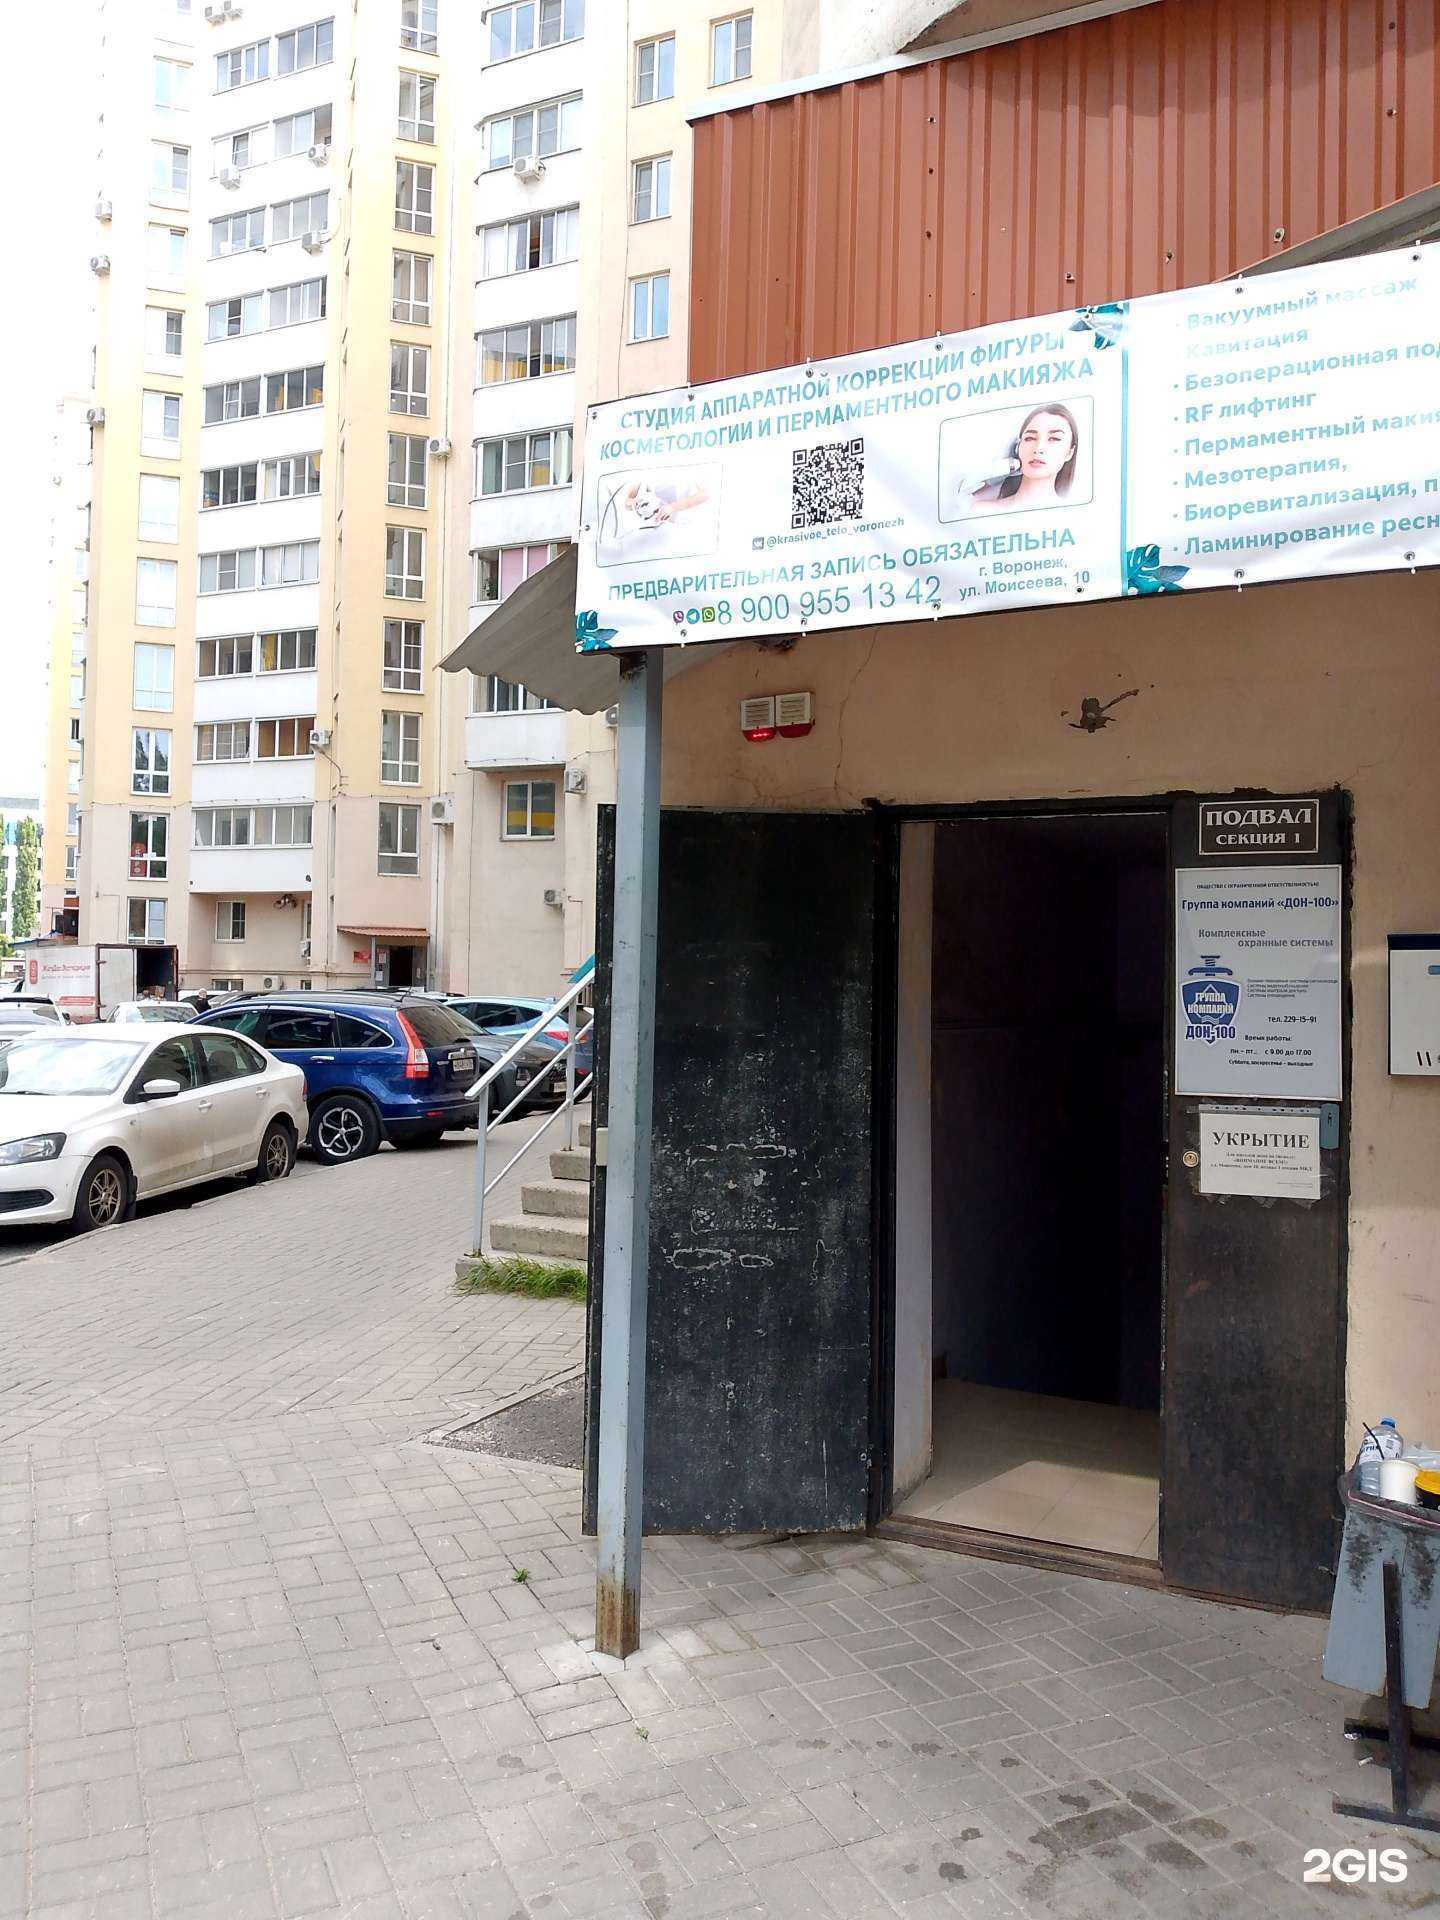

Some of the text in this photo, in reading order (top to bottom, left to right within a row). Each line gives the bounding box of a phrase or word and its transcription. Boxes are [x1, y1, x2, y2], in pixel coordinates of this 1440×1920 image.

[1187, 278, 1417, 330] Вакуумный массаж
[1186, 328, 1310, 359] Кавитация
[620, 331, 1065, 431] СТУДИЯ АППАРАТНОЙ КОРРЕКЦИИ ФИГУРЫ
[1185, 340, 1440, 392] Безоперационная по
[600, 357, 1094, 461] КОСМЕТОЛОГИИ И ПЕРМАМЕНТНОГО МАКИЯЖА
[1185, 393, 1317, 424] RF лифтинг
[1185, 415, 1366, 456] Пермаментный
[1184, 457, 1347, 488] Мезотерапия,
[1184, 481, 1417, 521] Биоревитализация,
[766, 517, 905, 548] @krasivoe_telo_voronezh
[1184, 520, 1375, 555] Ламинирование
[608, 527, 1076, 601] ПРЕДВАРИТЕЛЬНАЯ ЗАПИСЬ ОБЯЗАТЕЛЬНА
[979, 557, 1068, 576] г. Воронеж,
[718, 575, 942, 625] 8 900 955 13 42
[960, 570, 1090, 601] ул. Моисеева, 10
[1205, 808, 1312, 828] ПОДВАЛ
[1215, 832, 1300, 846] СЕКЦИЯ 1
[1181, 896, 1339, 911] Группа компаний «ДОН-100»
[1198, 929, 1266, 938] Комплексные
[1237, 938, 1334, 948] охранные системы
[1187, 1003, 1234, 1014] КОМПАНИЙ
[1195, 992, 1226, 1002] ГРУППА
[1185, 1025, 1236, 1040] ДОН-100
[1244, 1034, 1265, 1042] Время
[1212, 1131, 1310, 1148] УКРЫТИЕ
